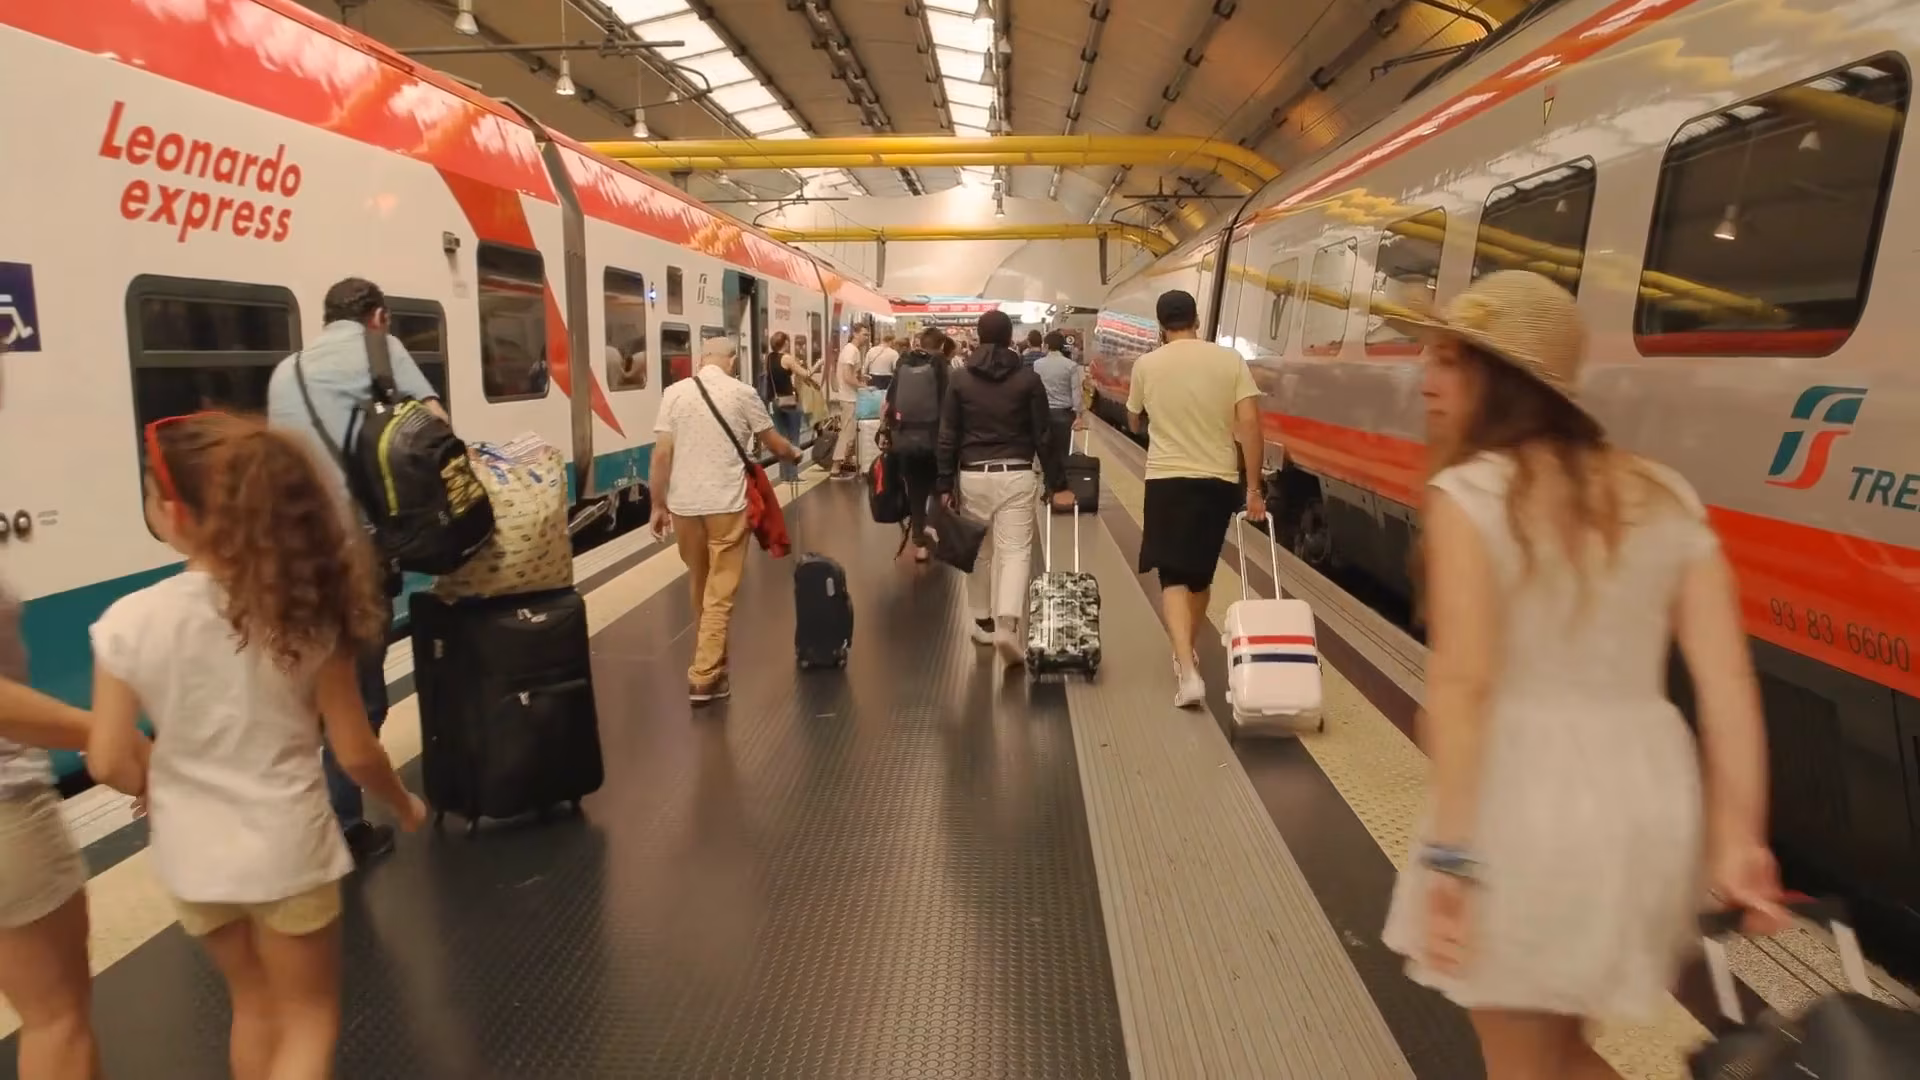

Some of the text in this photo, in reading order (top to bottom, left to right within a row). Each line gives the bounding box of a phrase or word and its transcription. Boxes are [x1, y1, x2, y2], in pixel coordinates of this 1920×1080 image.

[98, 100, 302, 197] Leonardo
[120, 180, 293, 243] express
[1848, 466, 1920, 512] TRE
[1770, 598, 1910, 673] 93 83 6600
